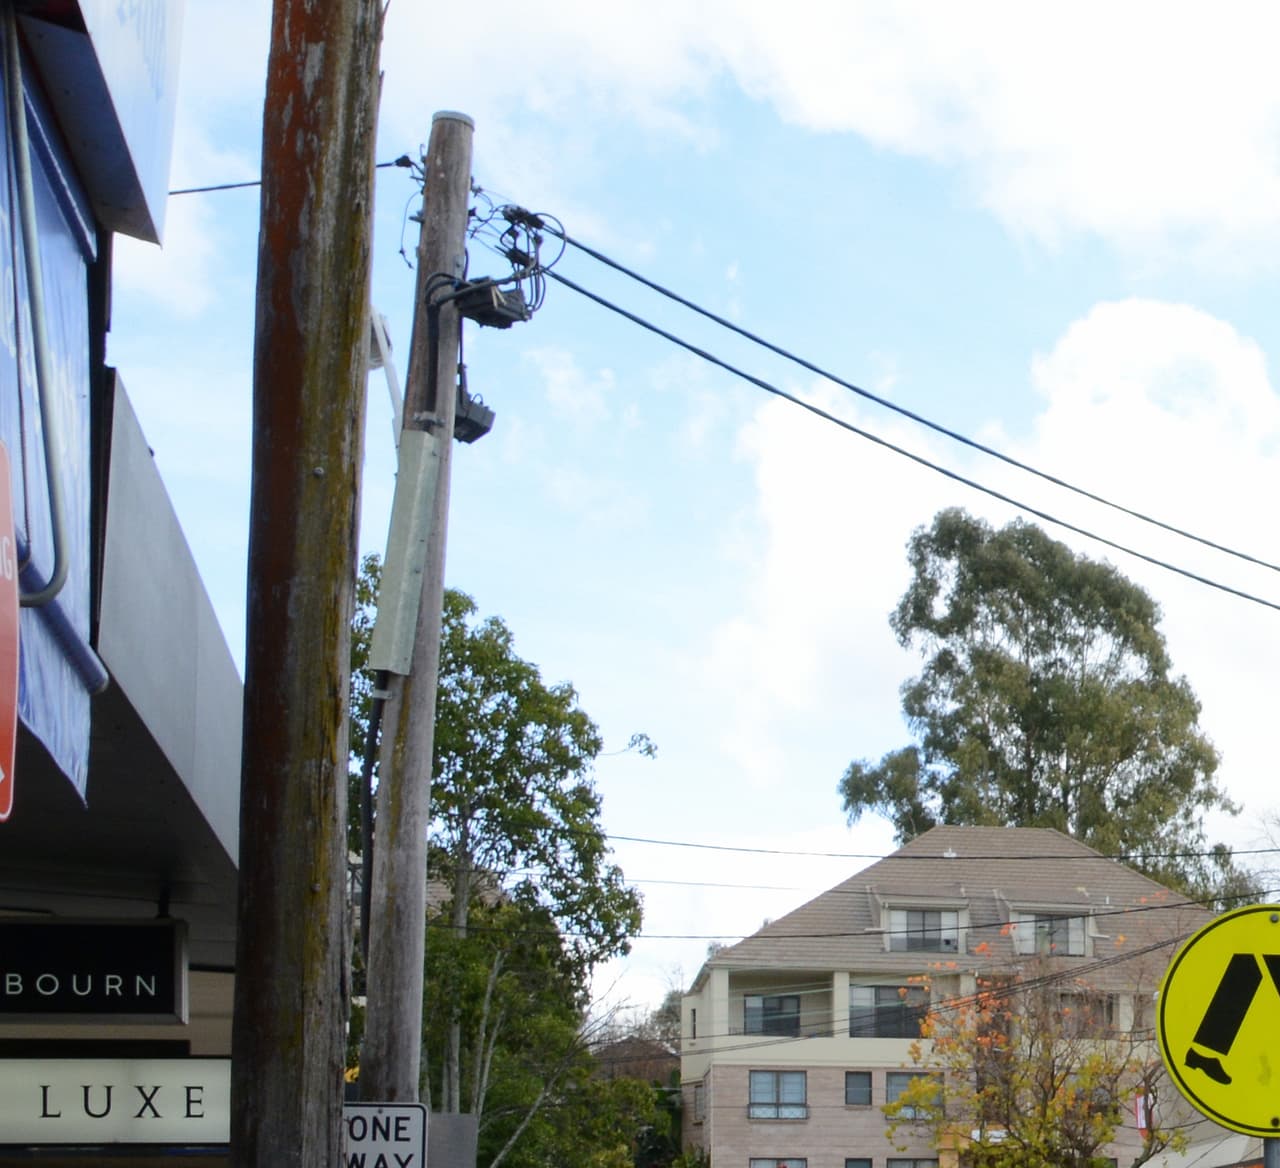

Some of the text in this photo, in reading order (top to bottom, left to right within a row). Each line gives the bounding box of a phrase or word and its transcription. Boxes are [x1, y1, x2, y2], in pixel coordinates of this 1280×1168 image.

[5, 972, 157, 997] BOURN
[39, 1085, 205, 1118] LUXE
[350, 1116, 411, 1142] ONE
